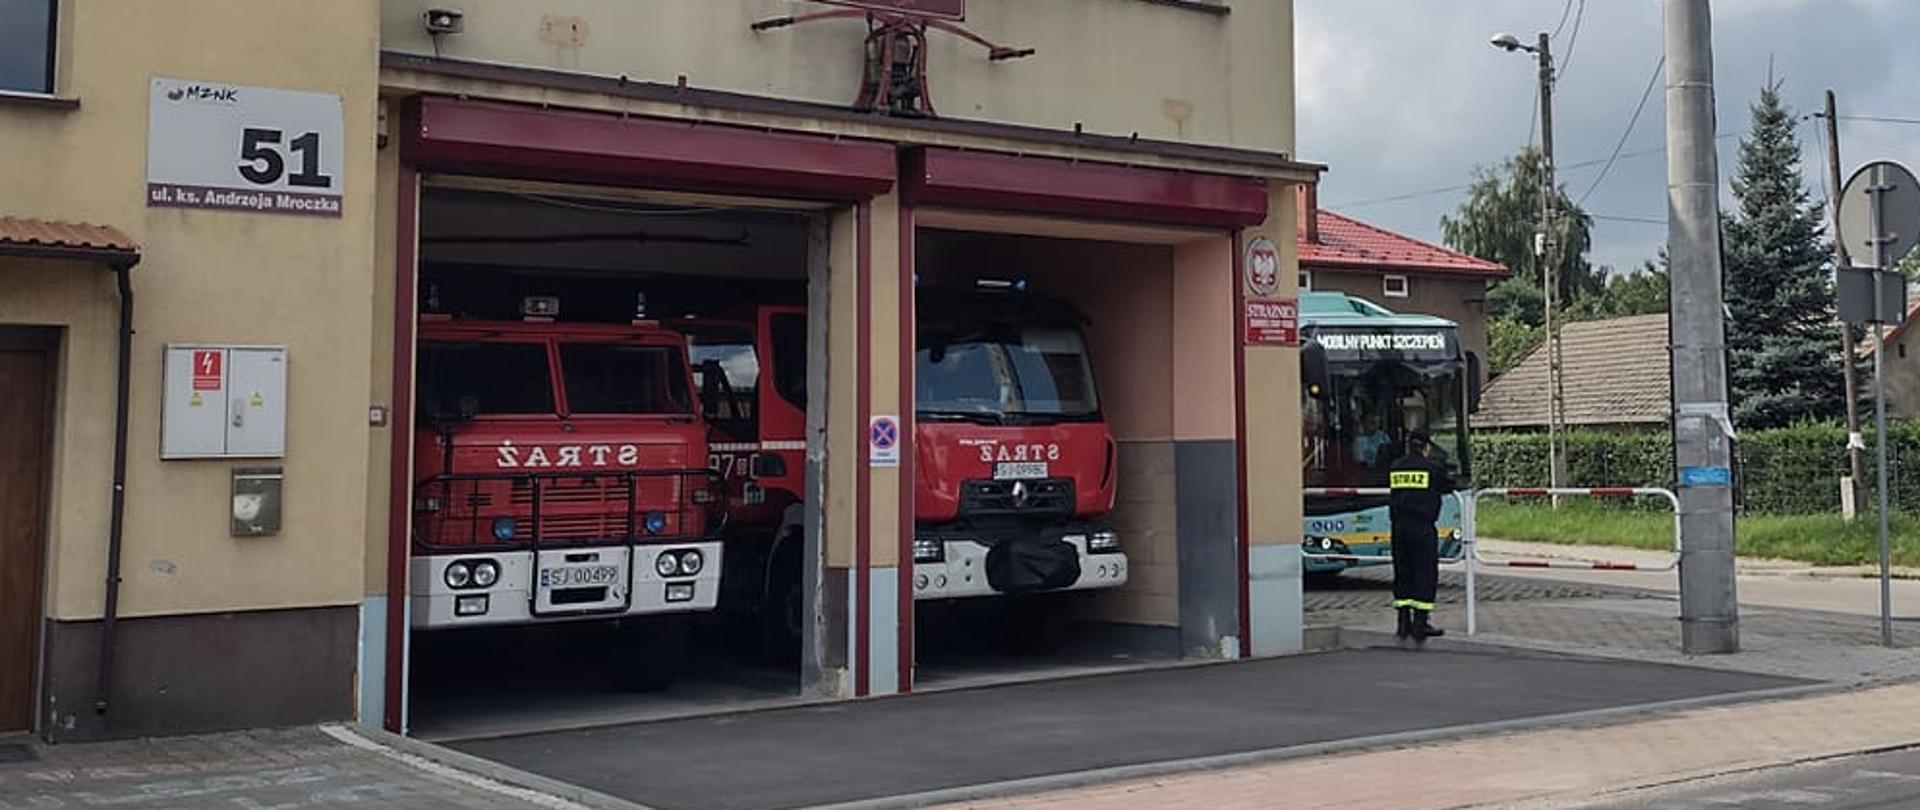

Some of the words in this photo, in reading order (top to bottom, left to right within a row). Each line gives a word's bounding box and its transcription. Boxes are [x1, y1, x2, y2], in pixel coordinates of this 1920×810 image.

[186, 85, 238, 102] MZNK
[238, 128, 331, 188] 51
[152, 187, 171, 202] ul.
[177, 188, 200, 203] ks.
[205, 190, 272, 210] Andrzeja
[276, 194, 339, 211] Mroczka
[1360, 334, 1391, 350] PUNKT
